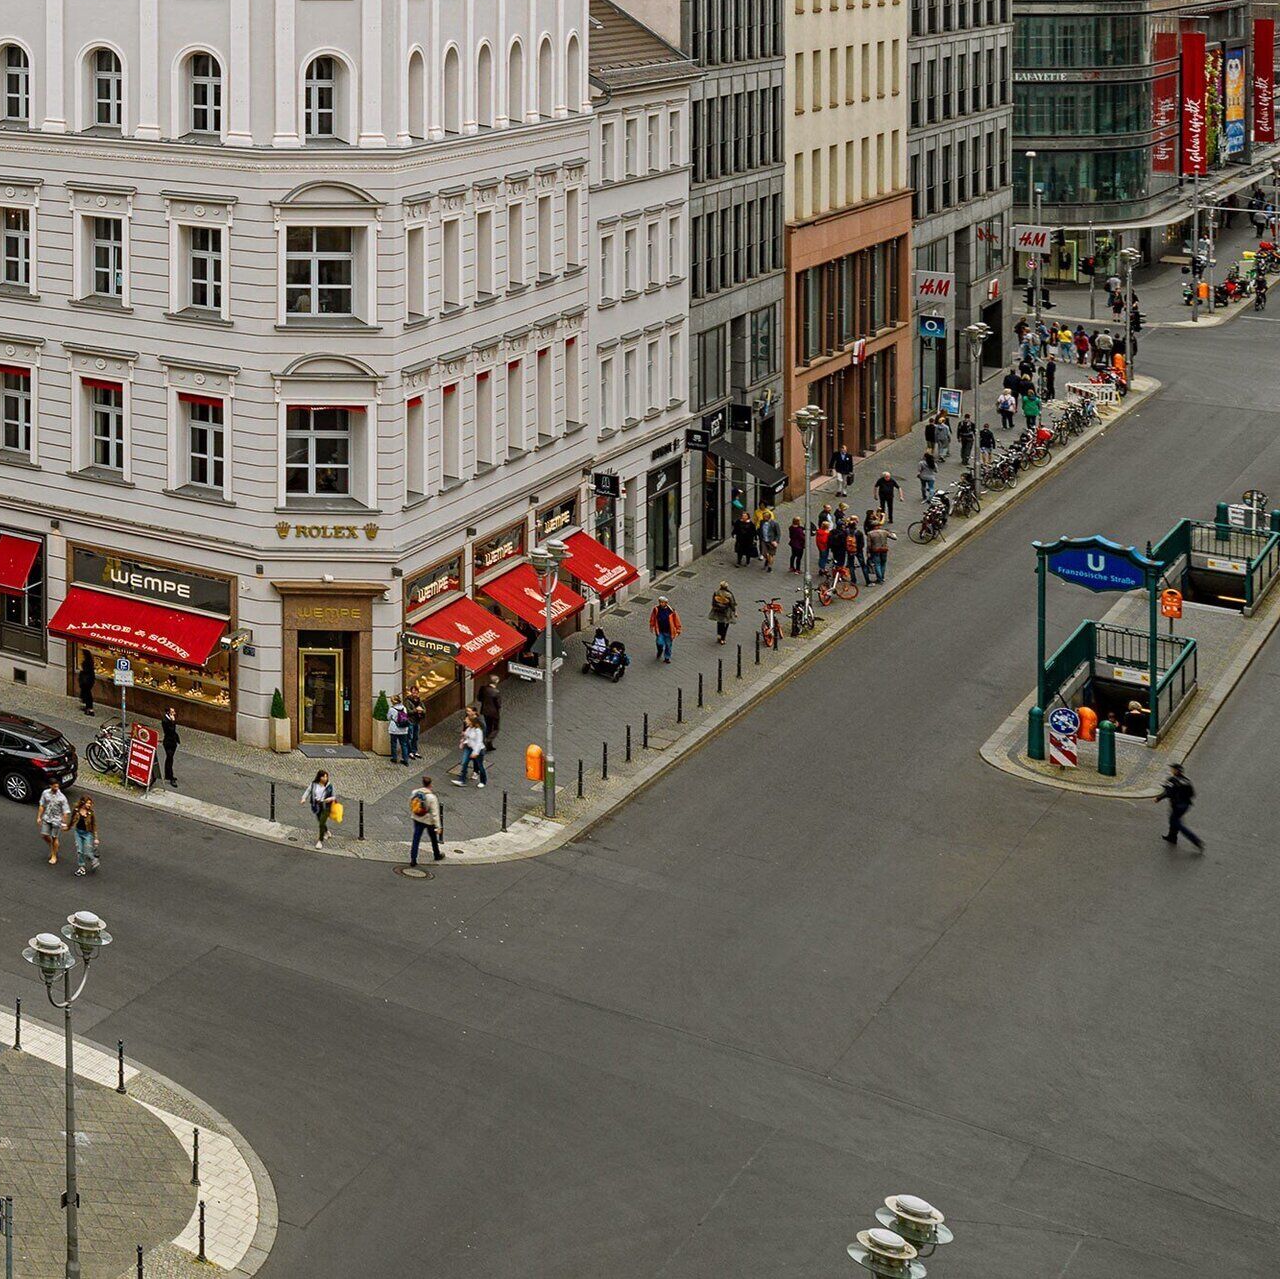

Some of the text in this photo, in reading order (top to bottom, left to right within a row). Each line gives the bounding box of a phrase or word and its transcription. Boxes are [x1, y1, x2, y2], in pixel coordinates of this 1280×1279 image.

[1015, 72, 1068, 81] LAFAYETTE
[295, 525, 359, 539] ROLEX
[484, 541, 514, 567] WEMPE
[1087, 553, 1105, 572] U
[110, 568, 191, 599] WEMPE
[1057, 566, 1136, 585] Französische Straße
[417, 575, 450, 603] WEMPE
[297, 607, 361, 619] WEMPE
[134, 628, 146, 637] &
[148, 633, 190, 659] SÖHNE
[408, 638, 451, 654] WEMPE
